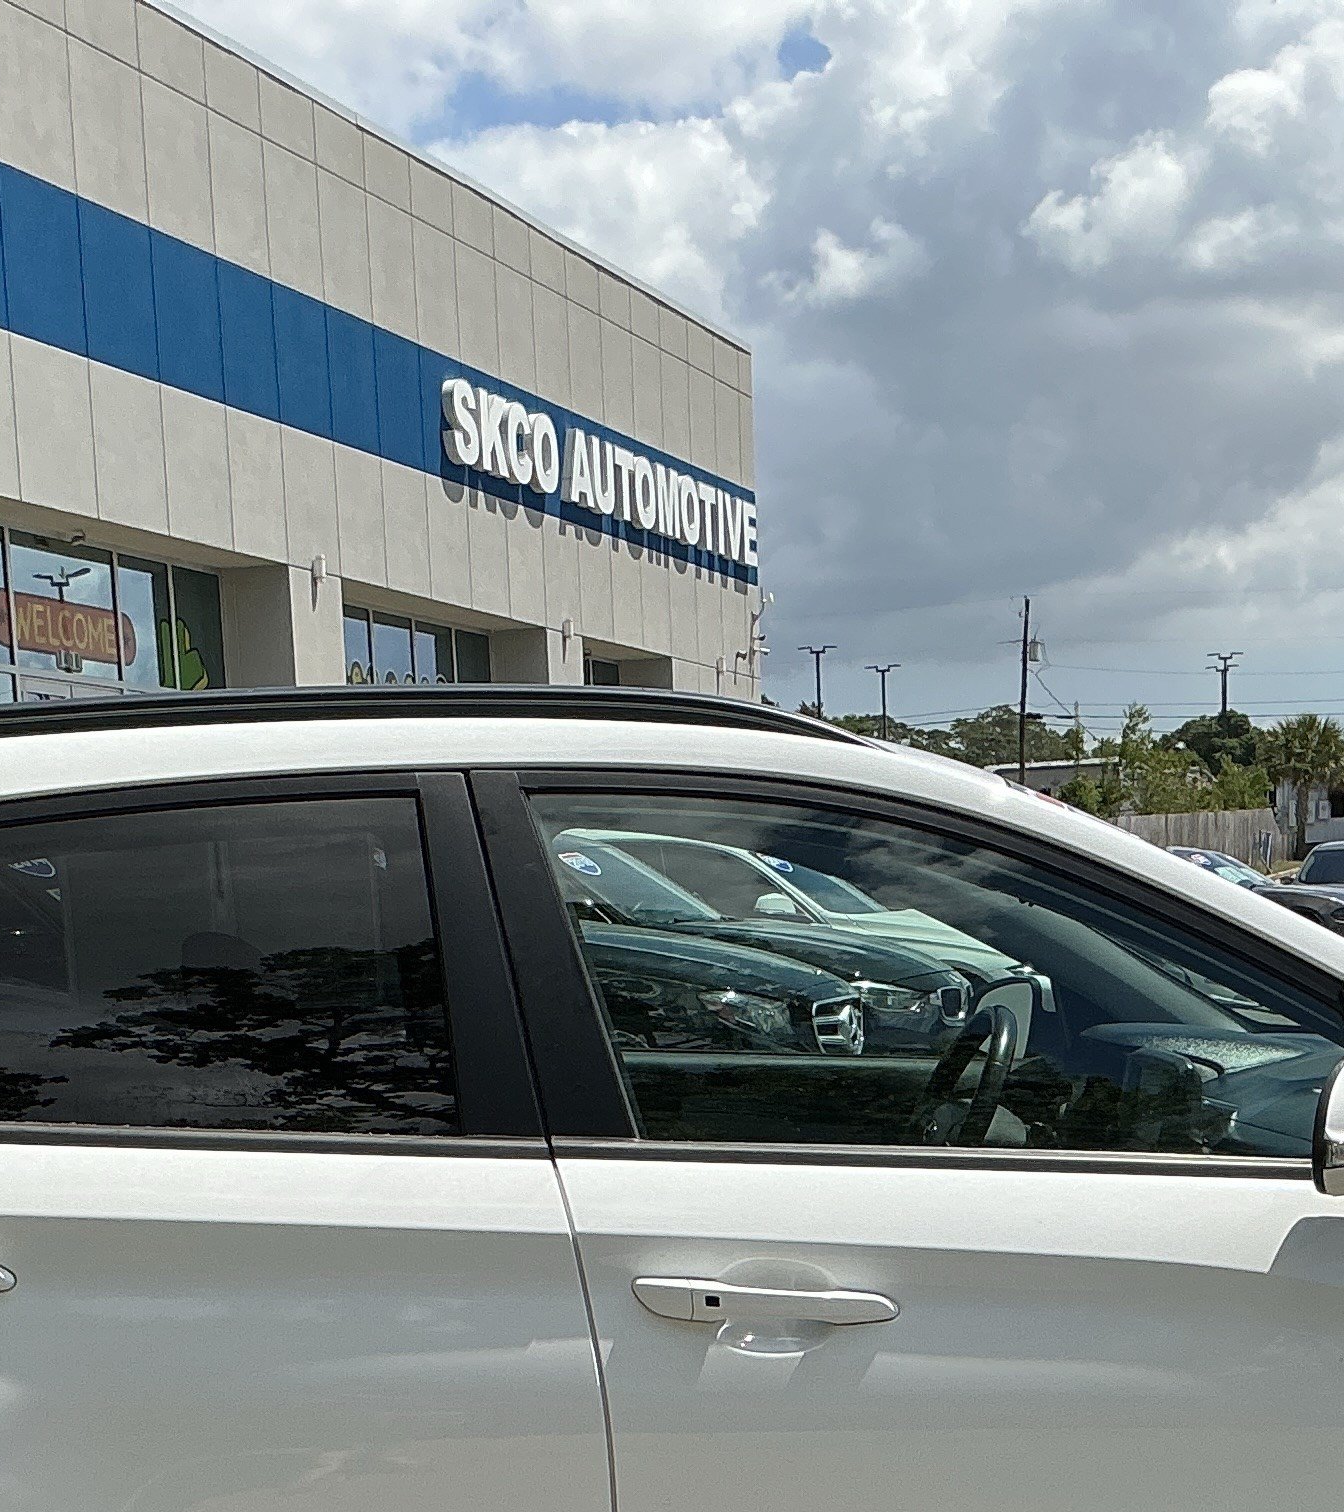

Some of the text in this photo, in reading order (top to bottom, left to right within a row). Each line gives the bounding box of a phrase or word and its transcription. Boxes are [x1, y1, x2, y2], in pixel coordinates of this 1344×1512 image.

[442, 378, 759, 567] SKCO AUTOMOTIVE
[15, 602, 117, 655] WELCOME
